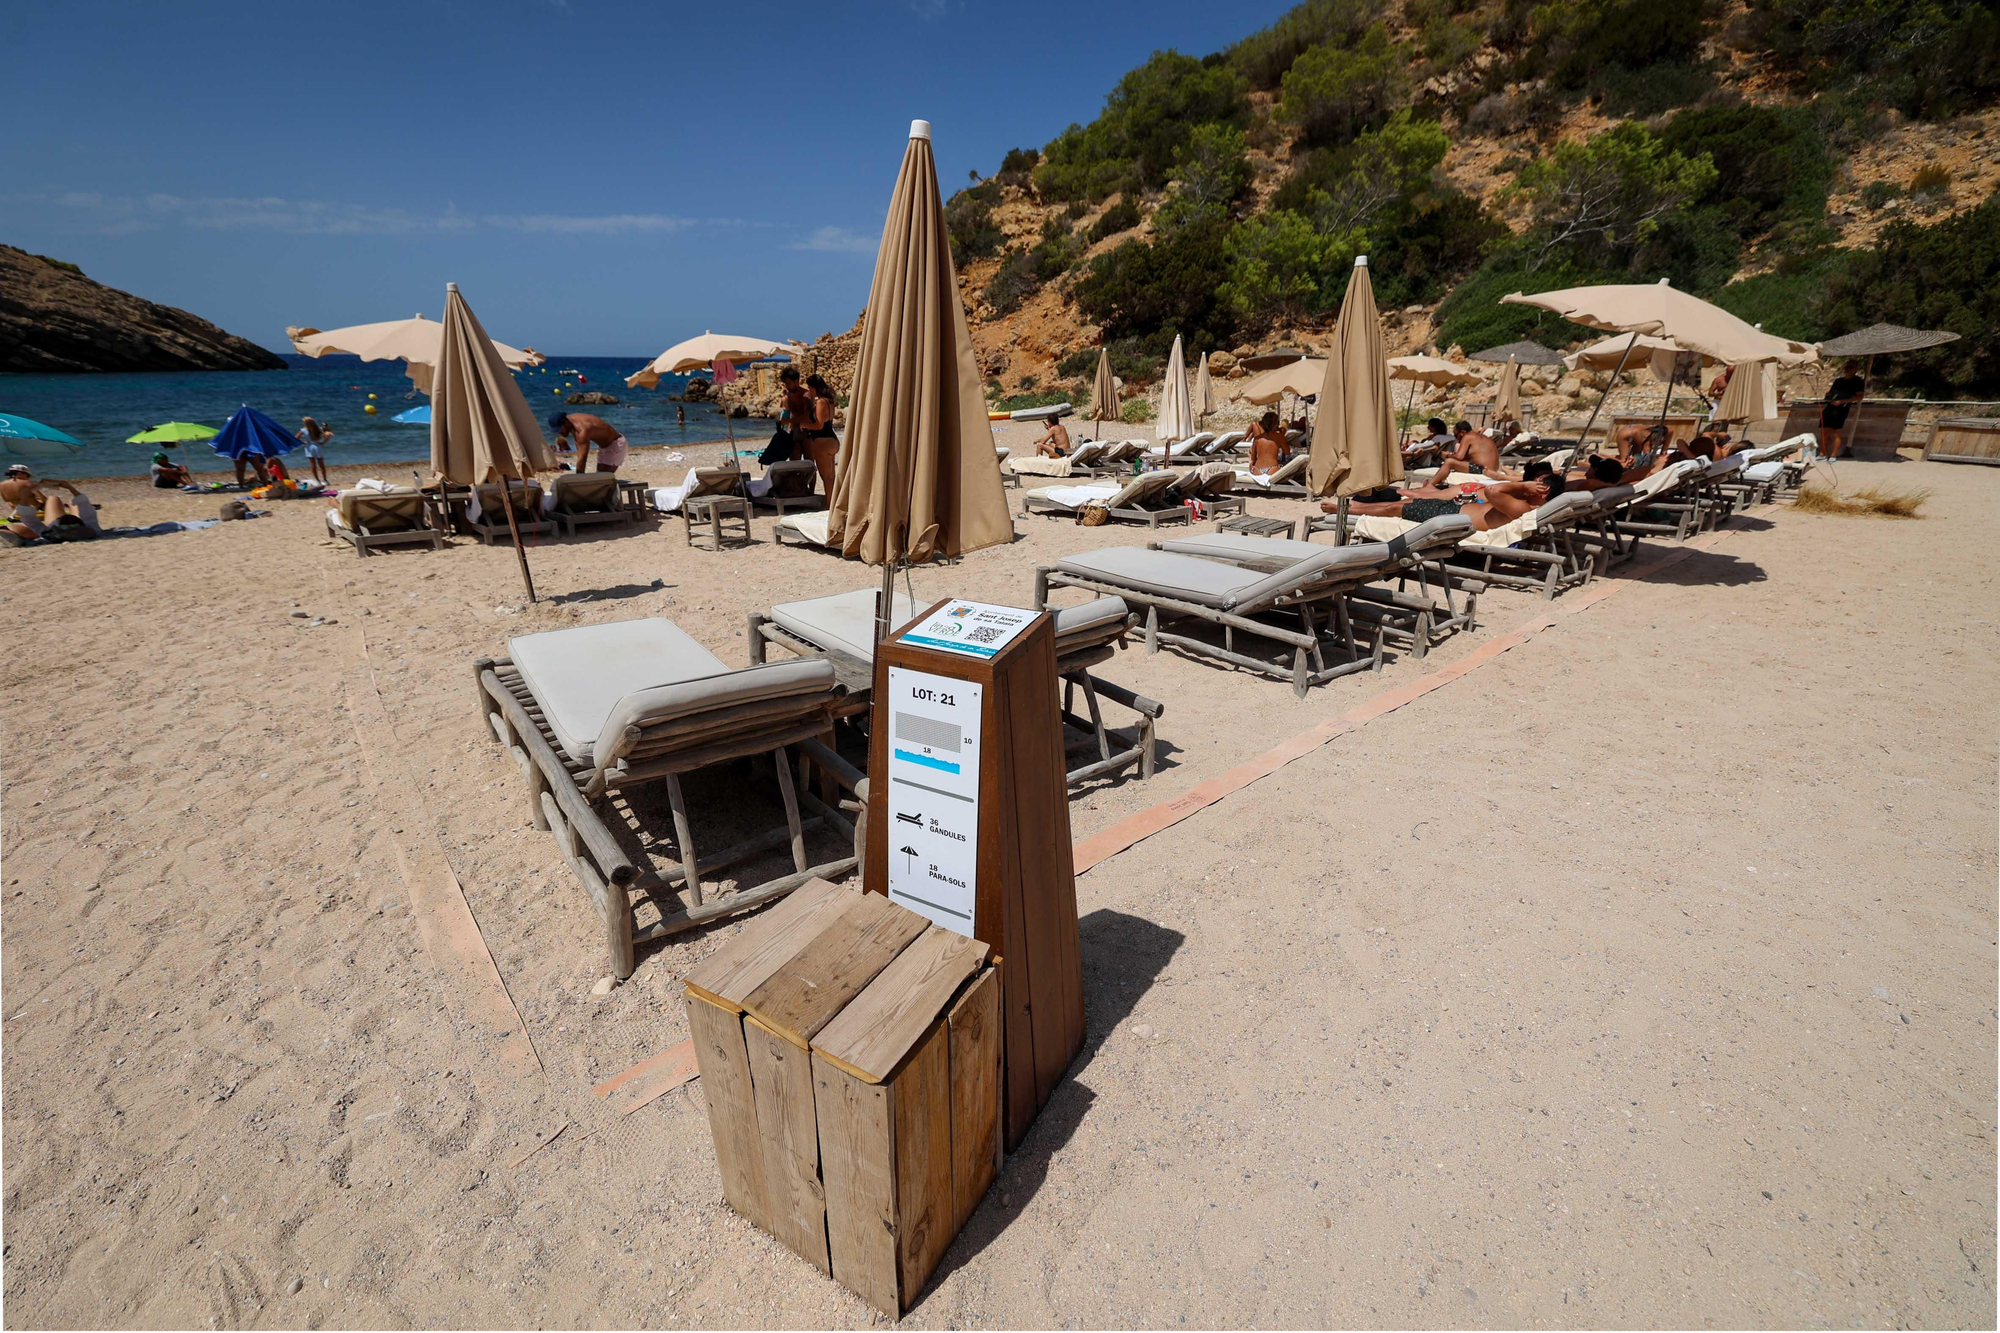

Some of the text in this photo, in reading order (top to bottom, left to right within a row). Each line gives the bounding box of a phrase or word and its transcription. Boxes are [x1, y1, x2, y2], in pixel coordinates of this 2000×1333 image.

[998, 616, 1023, 624] Josep
[912, 687, 956, 707] LOT: 21
[963, 737, 973, 745] 10
[929, 818, 939, 826] 36
[929, 826, 967, 842] GANDULES
[929, 864, 938, 872] 18
[929, 871, 966, 888] PARA-SOLS
